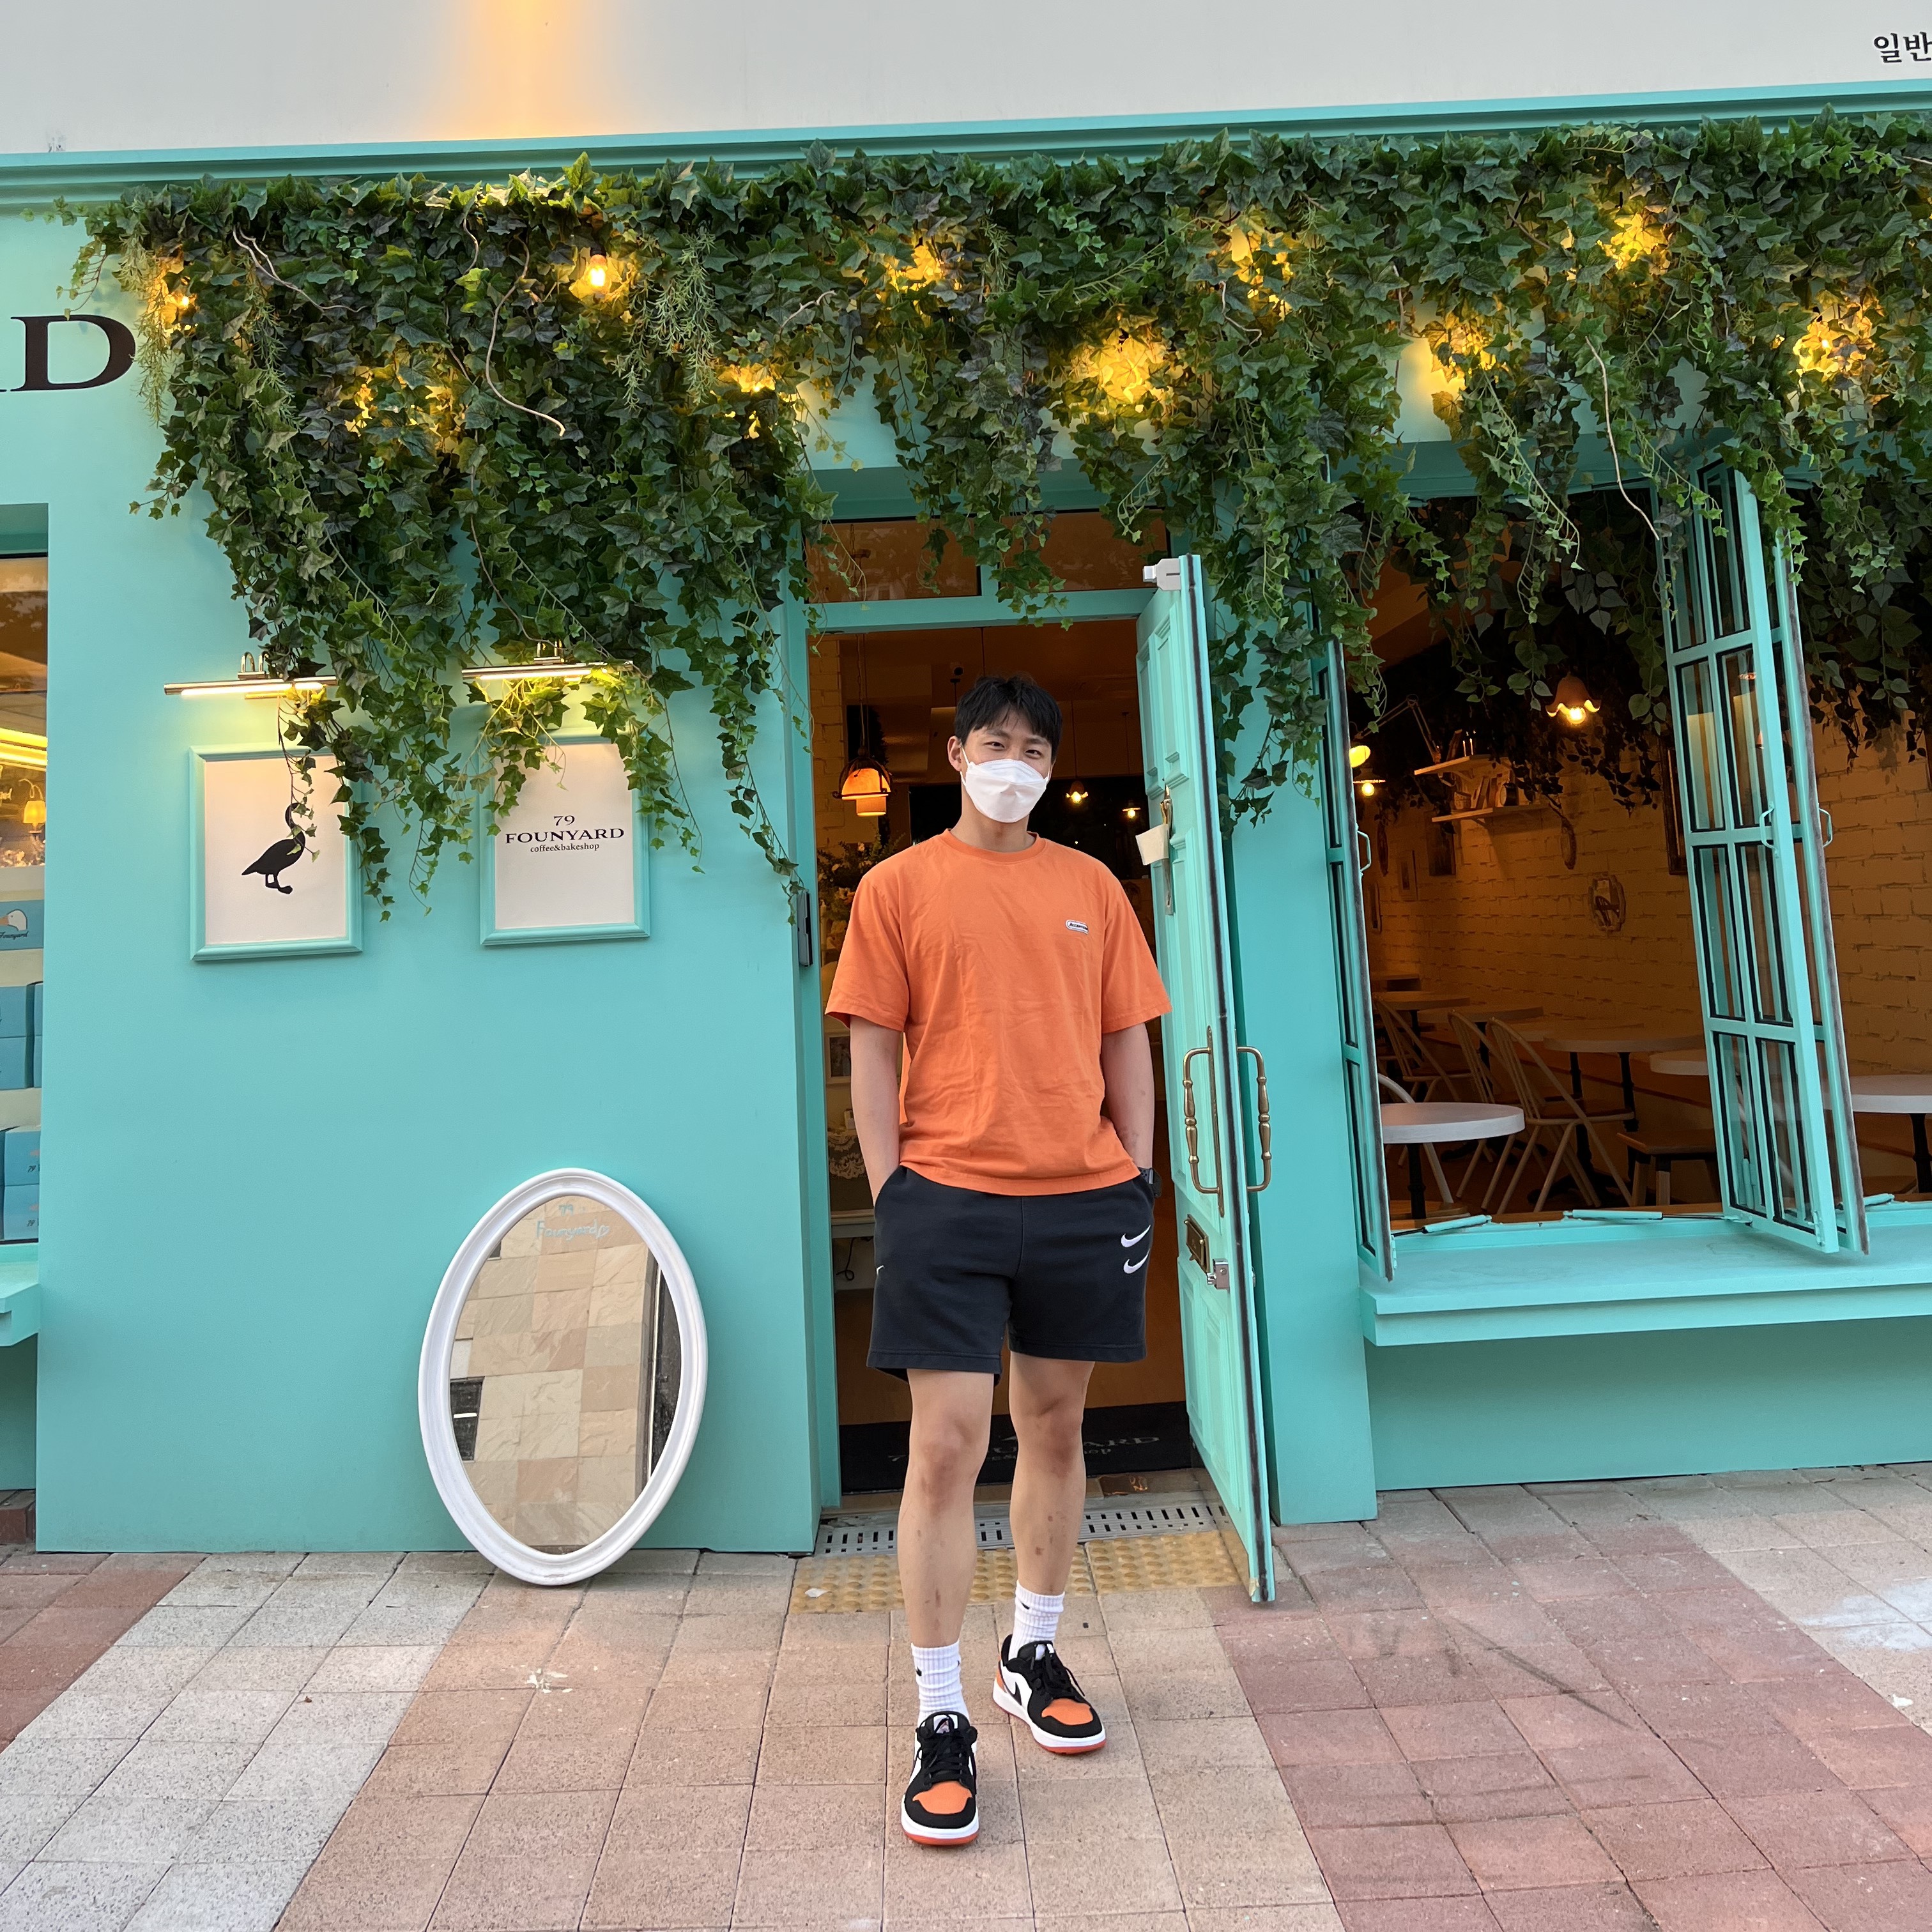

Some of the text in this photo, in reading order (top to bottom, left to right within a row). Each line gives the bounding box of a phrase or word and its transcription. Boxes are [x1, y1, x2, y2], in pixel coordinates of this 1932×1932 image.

[1873, 31, 1932, 63] 일반
[0, 314, 136, 392] D
[553, 815, 575, 826] 79
[505, 828, 625, 844] FOUNYARD
[530, 842, 600, 853] coffee&bakeshop
